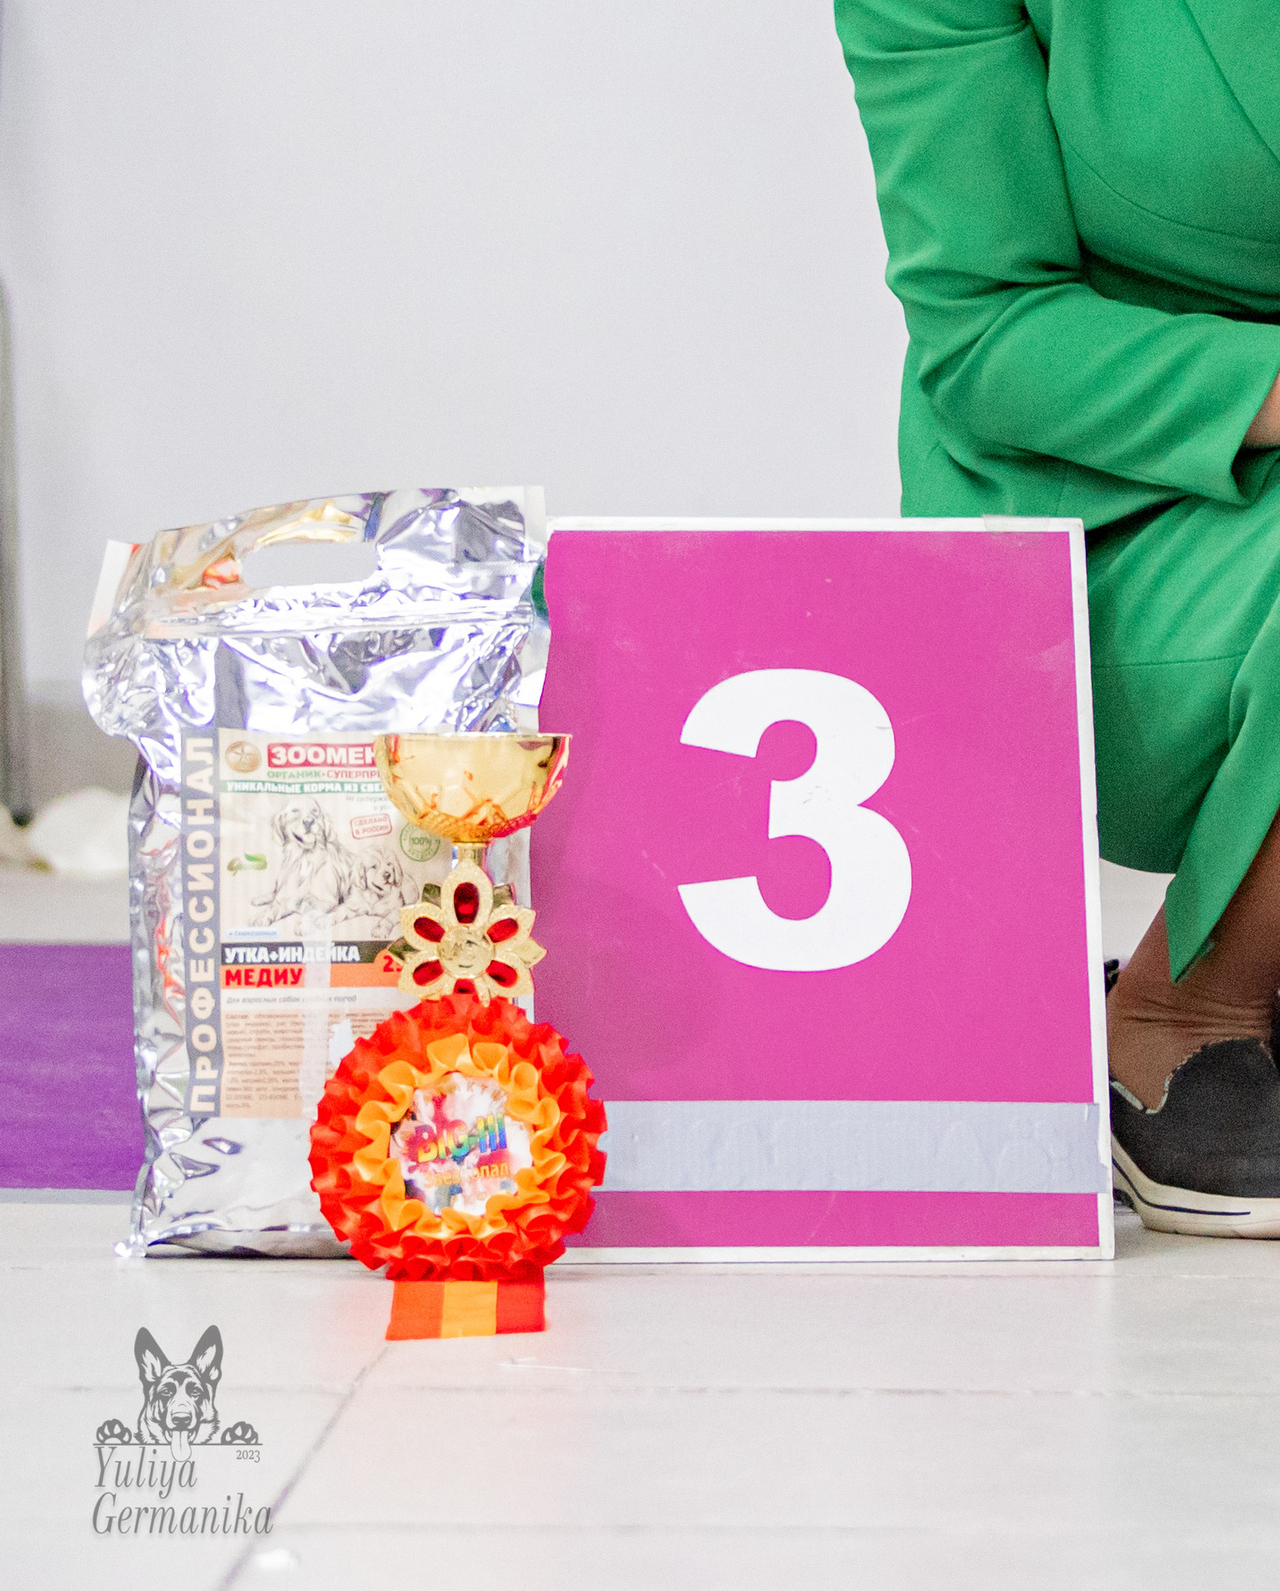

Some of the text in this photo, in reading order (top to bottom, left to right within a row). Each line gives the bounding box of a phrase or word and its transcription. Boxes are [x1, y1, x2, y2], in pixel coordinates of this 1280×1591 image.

[227, 782, 301, 793] УНИКАЛЬНЫЕ
[303, 783, 342, 793] КОРМА
[344, 783, 359, 793] ИЗ
[677, 668, 913, 973] 3
[185, 737, 217, 1113] ПРОФЕССИОНАЛ
[225, 968, 304, 987] МЕДИУ
